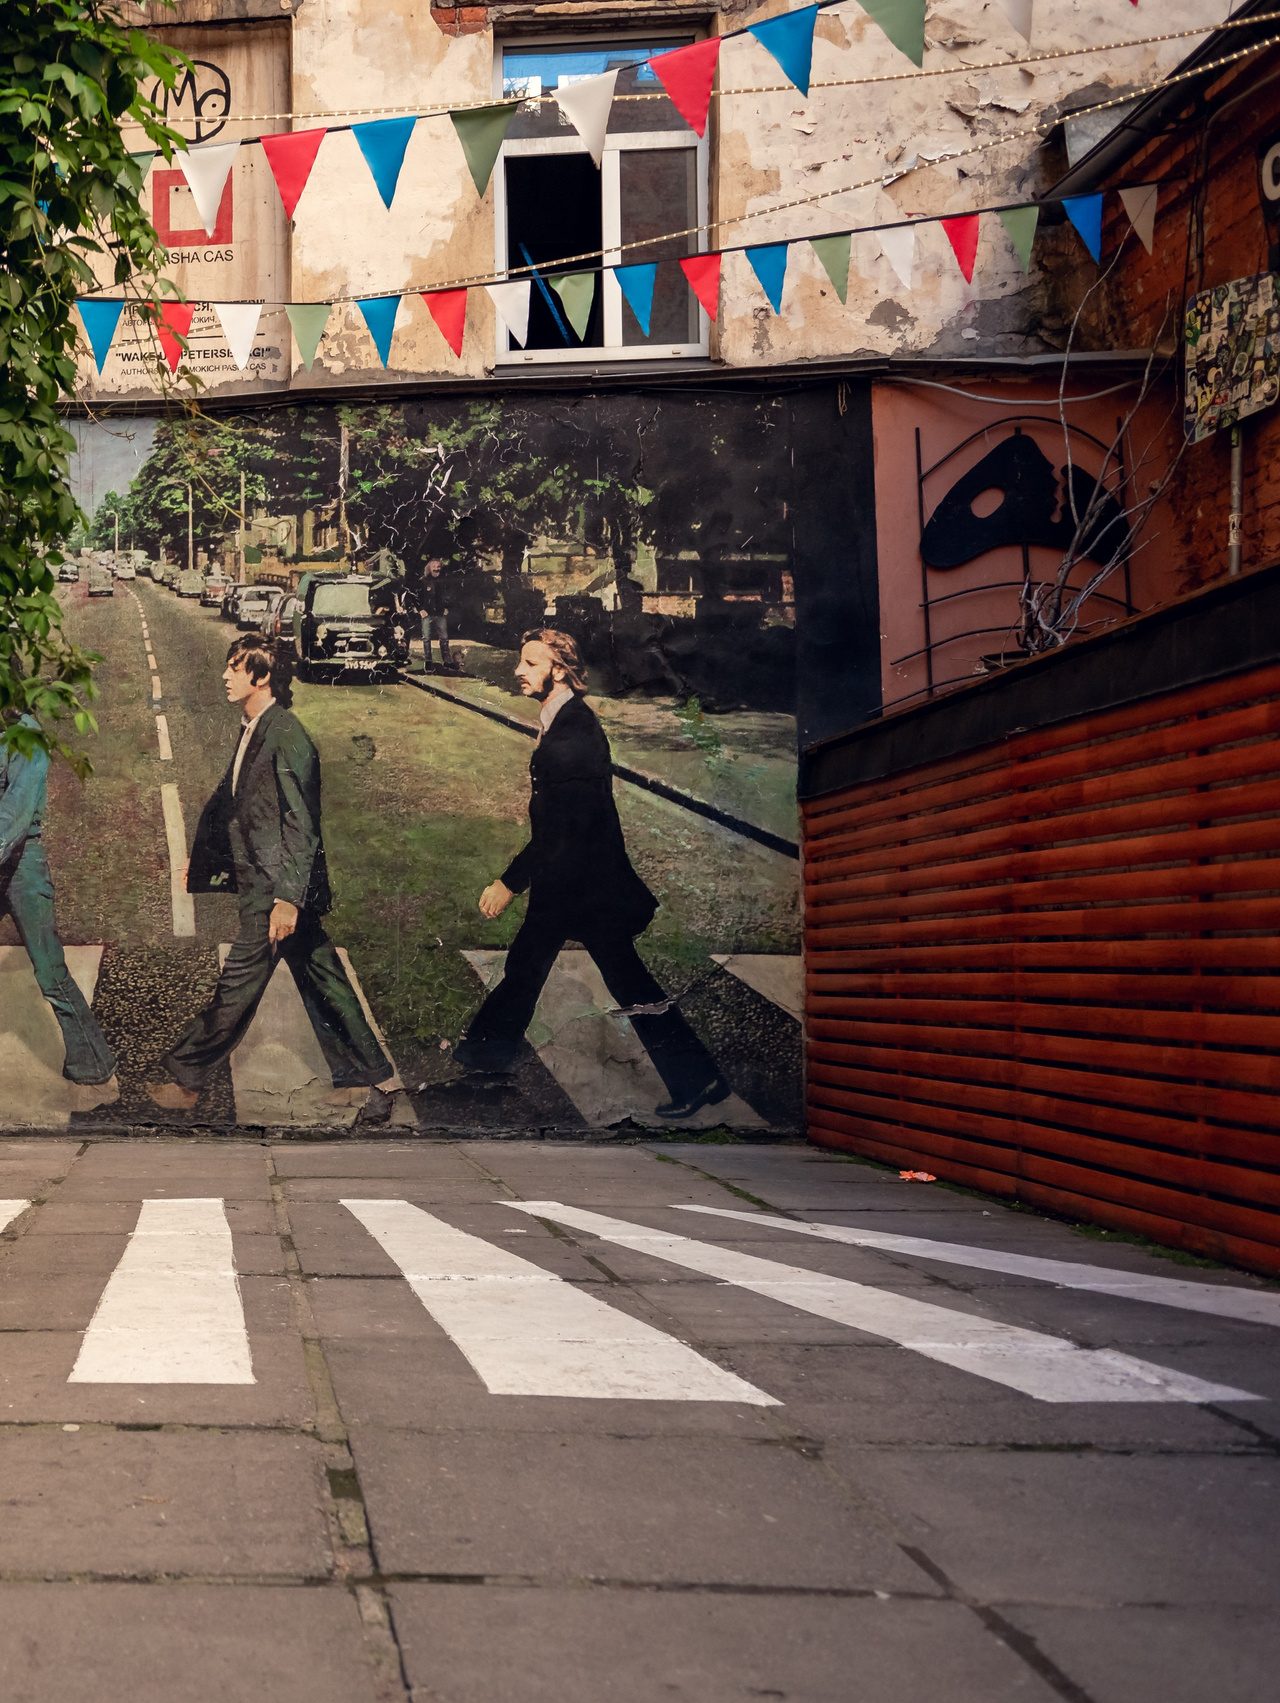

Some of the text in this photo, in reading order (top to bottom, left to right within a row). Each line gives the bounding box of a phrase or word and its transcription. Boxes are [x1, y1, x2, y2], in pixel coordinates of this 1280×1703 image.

[203, 250, 234, 263] CAS
[221, 363, 249, 372] PAS
[250, 362, 267, 371] CAS
